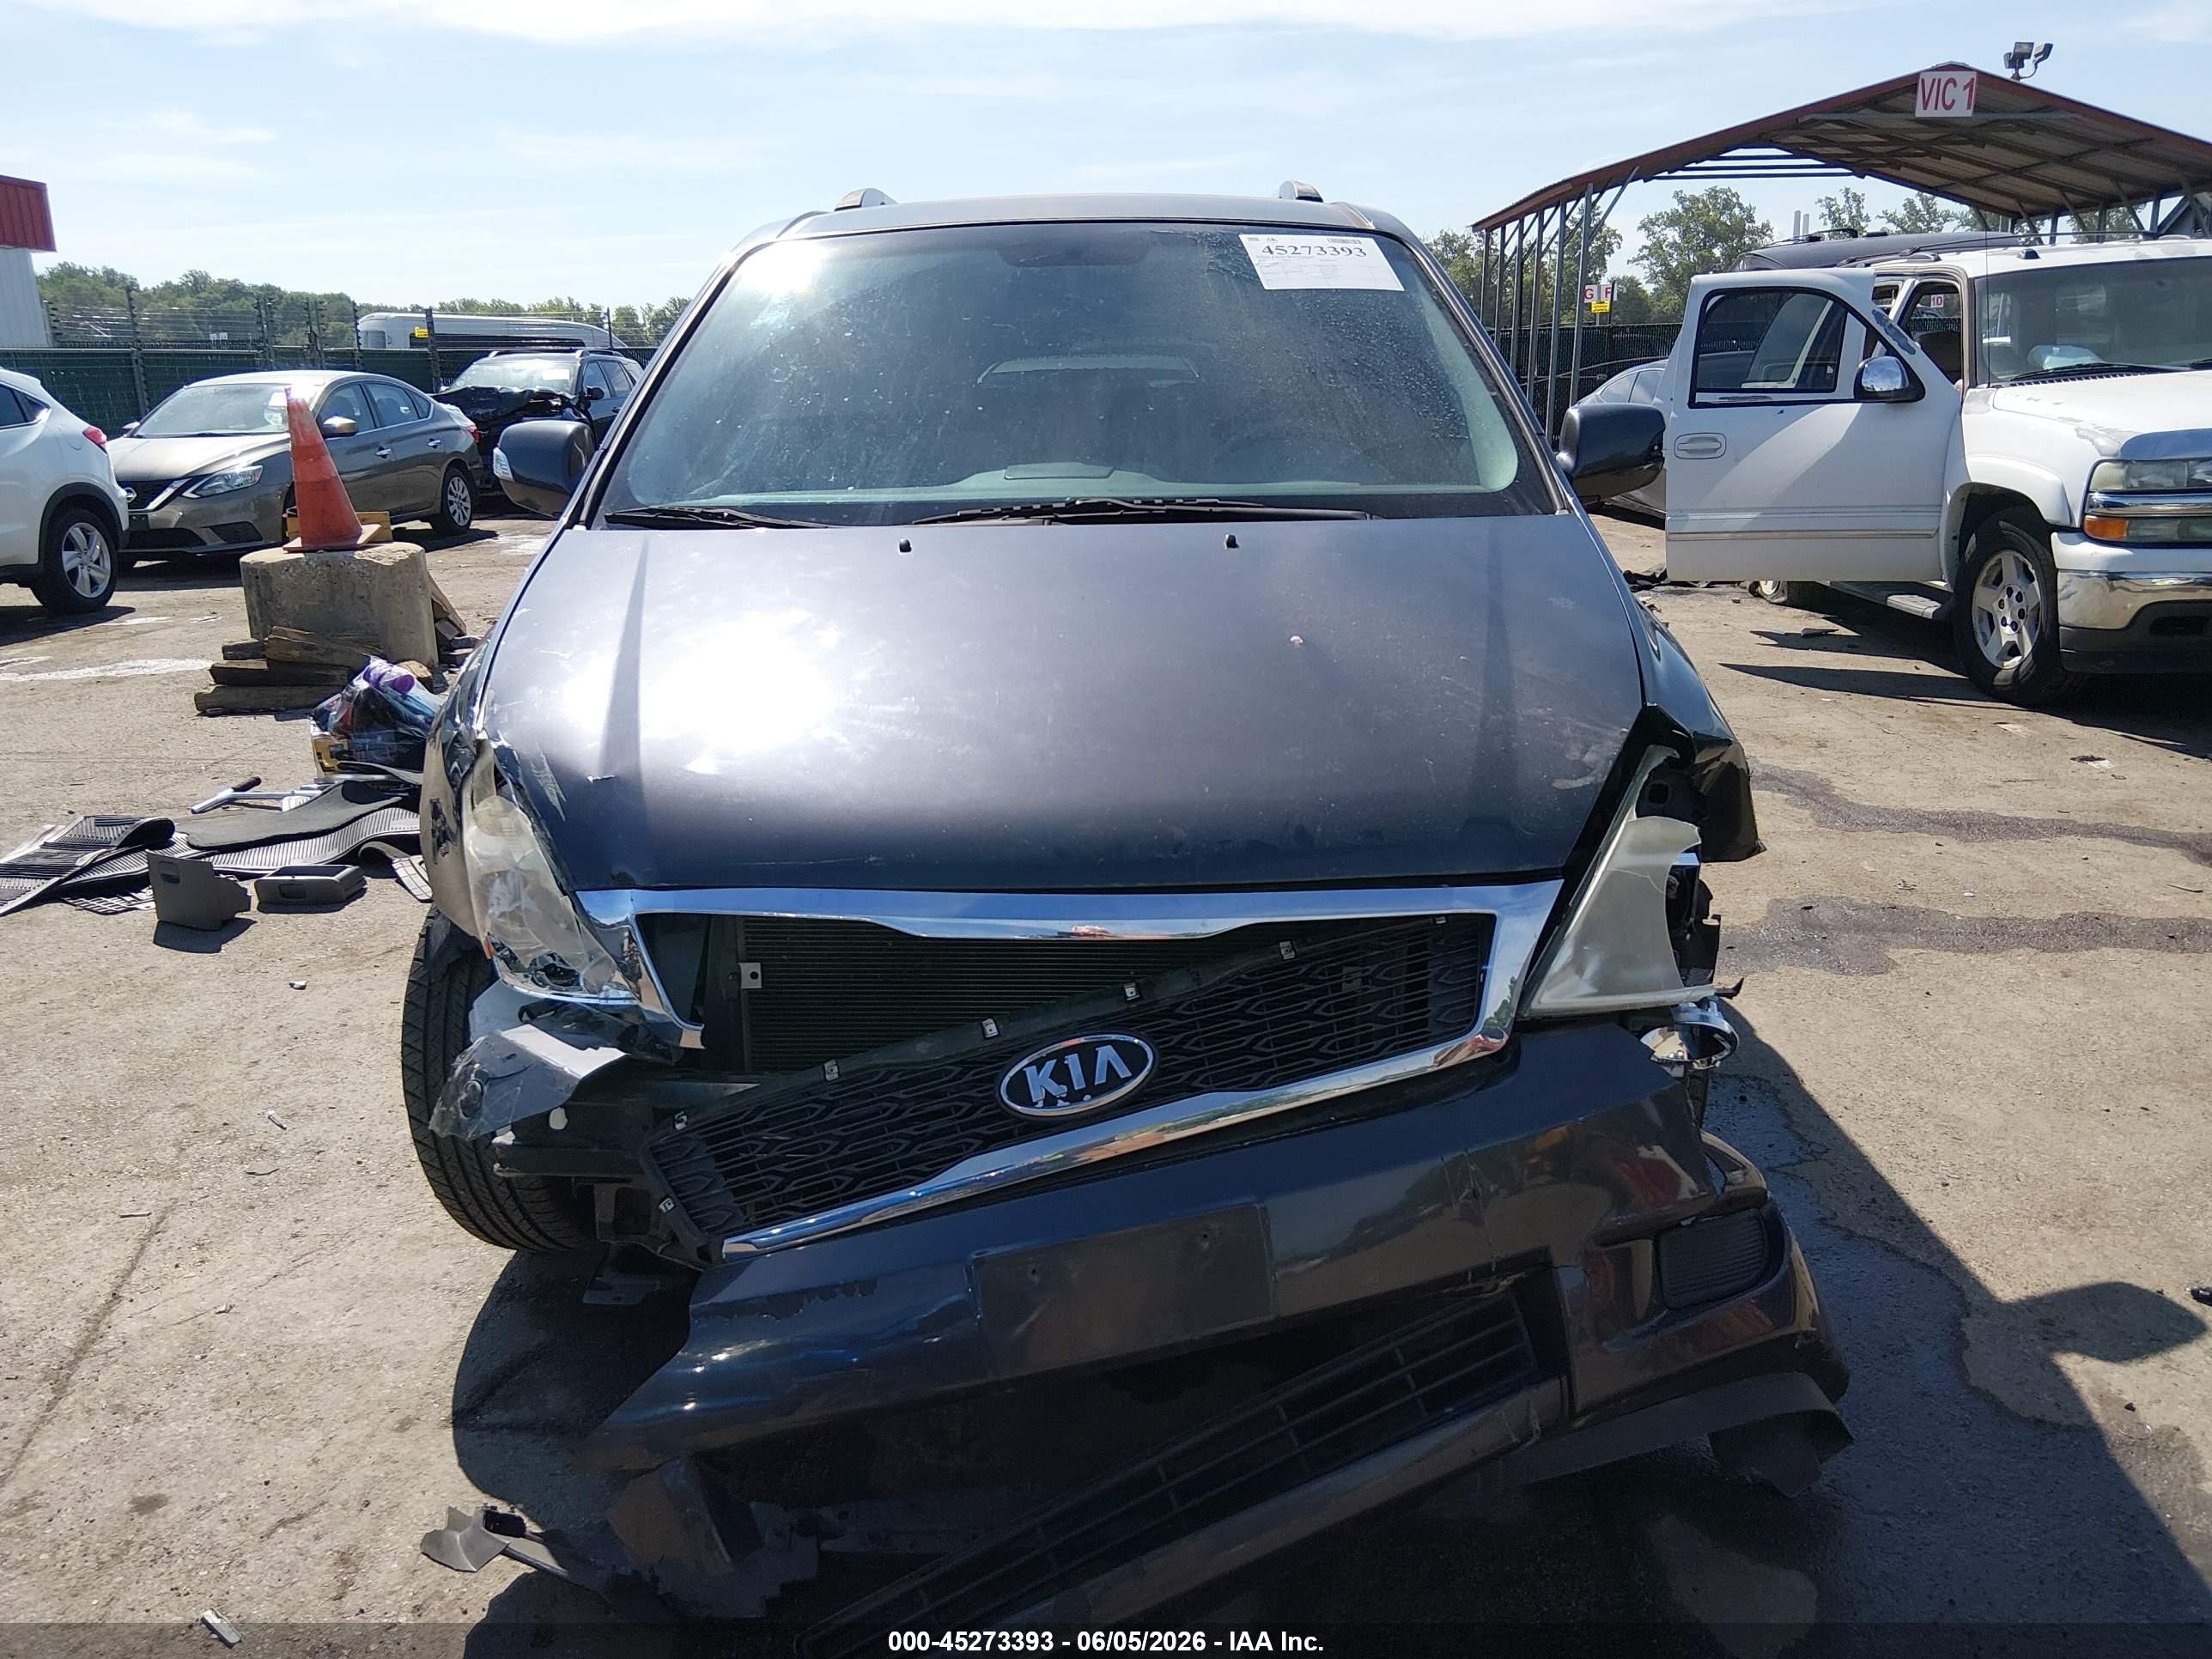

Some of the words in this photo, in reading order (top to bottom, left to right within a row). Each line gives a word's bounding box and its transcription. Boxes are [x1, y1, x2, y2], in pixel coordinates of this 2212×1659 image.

[1921, 77, 1958, 111] VIC
[1963, 77, 1974, 110] 1
[1261, 245, 1367, 257] 45273393
[1584, 288, 1594, 300] G
[1931, 296, 1943, 306] 10
[1023, 1044, 1133, 1103] KIA
